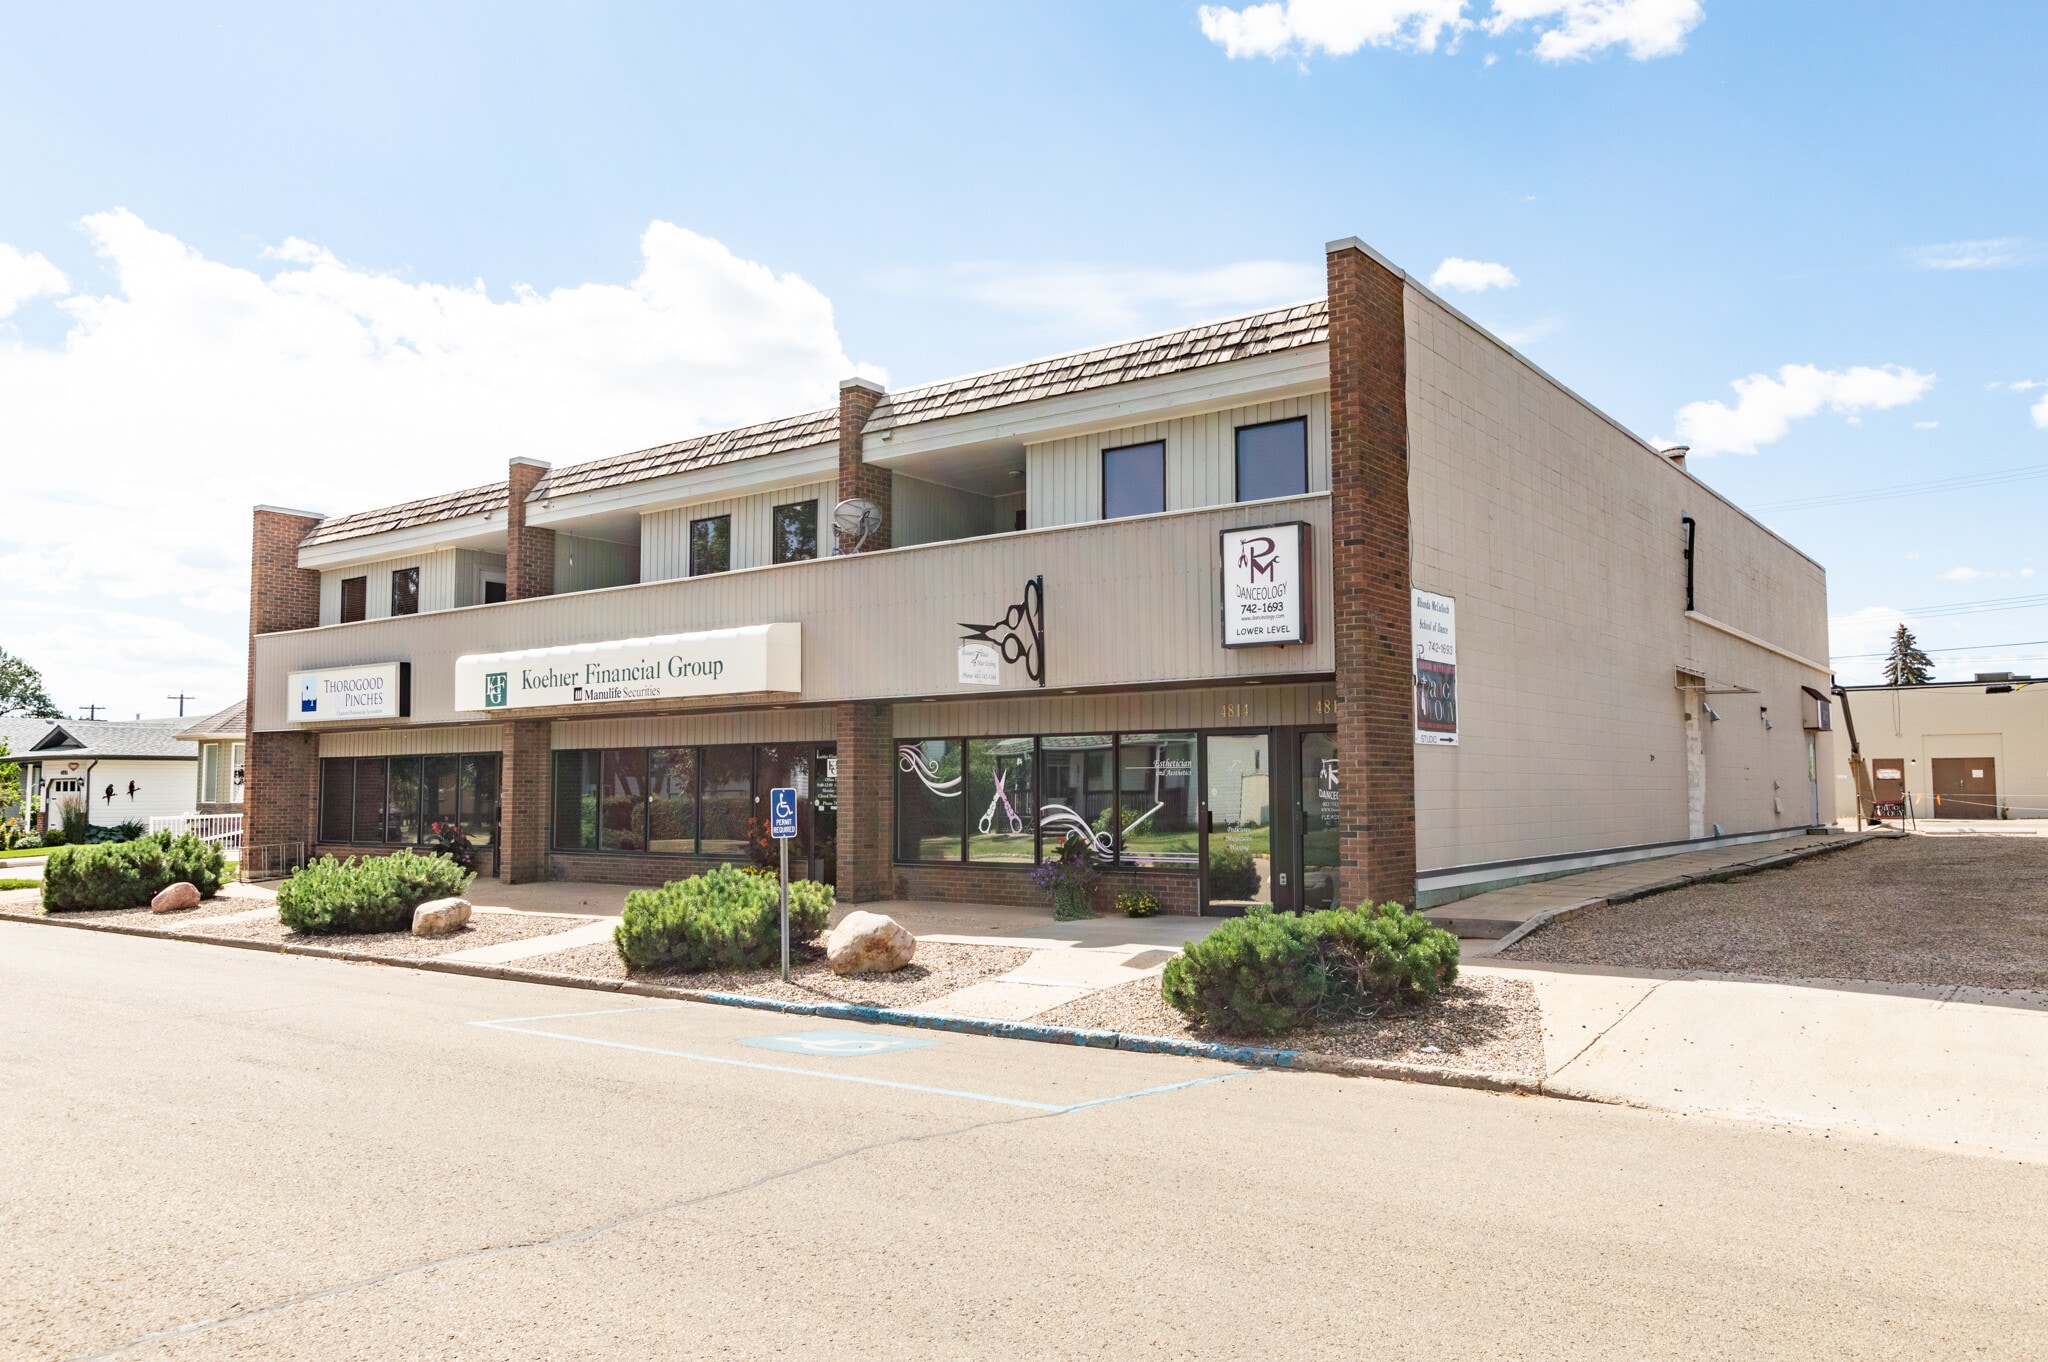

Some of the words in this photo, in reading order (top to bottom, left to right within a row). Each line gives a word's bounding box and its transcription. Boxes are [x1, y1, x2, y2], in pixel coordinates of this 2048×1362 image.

[1236, 582, 1287, 600] DANCEOLOGY
[1241, 602, 1284, 614] 742-1693
[1236, 627, 1264, 636] LOWER
[1267, 625, 1291, 634] LEVEL
[585, 658, 661, 684] Financial
[668, 655, 724, 680] Group
[324, 677, 384, 693] THOROGOOD
[584, 687, 622, 700] Manulife
[623, 684, 661, 698] Securities
[345, 692, 384, 707] PINCHES
[1221, 703, 1249, 717] 4814
[1421, 735, 1438, 744] STUDIO
[1153, 758, 1192, 767] Esthetician
[776, 818, 792, 826] PERMIT
[773, 826, 796, 834] REQUIRED
